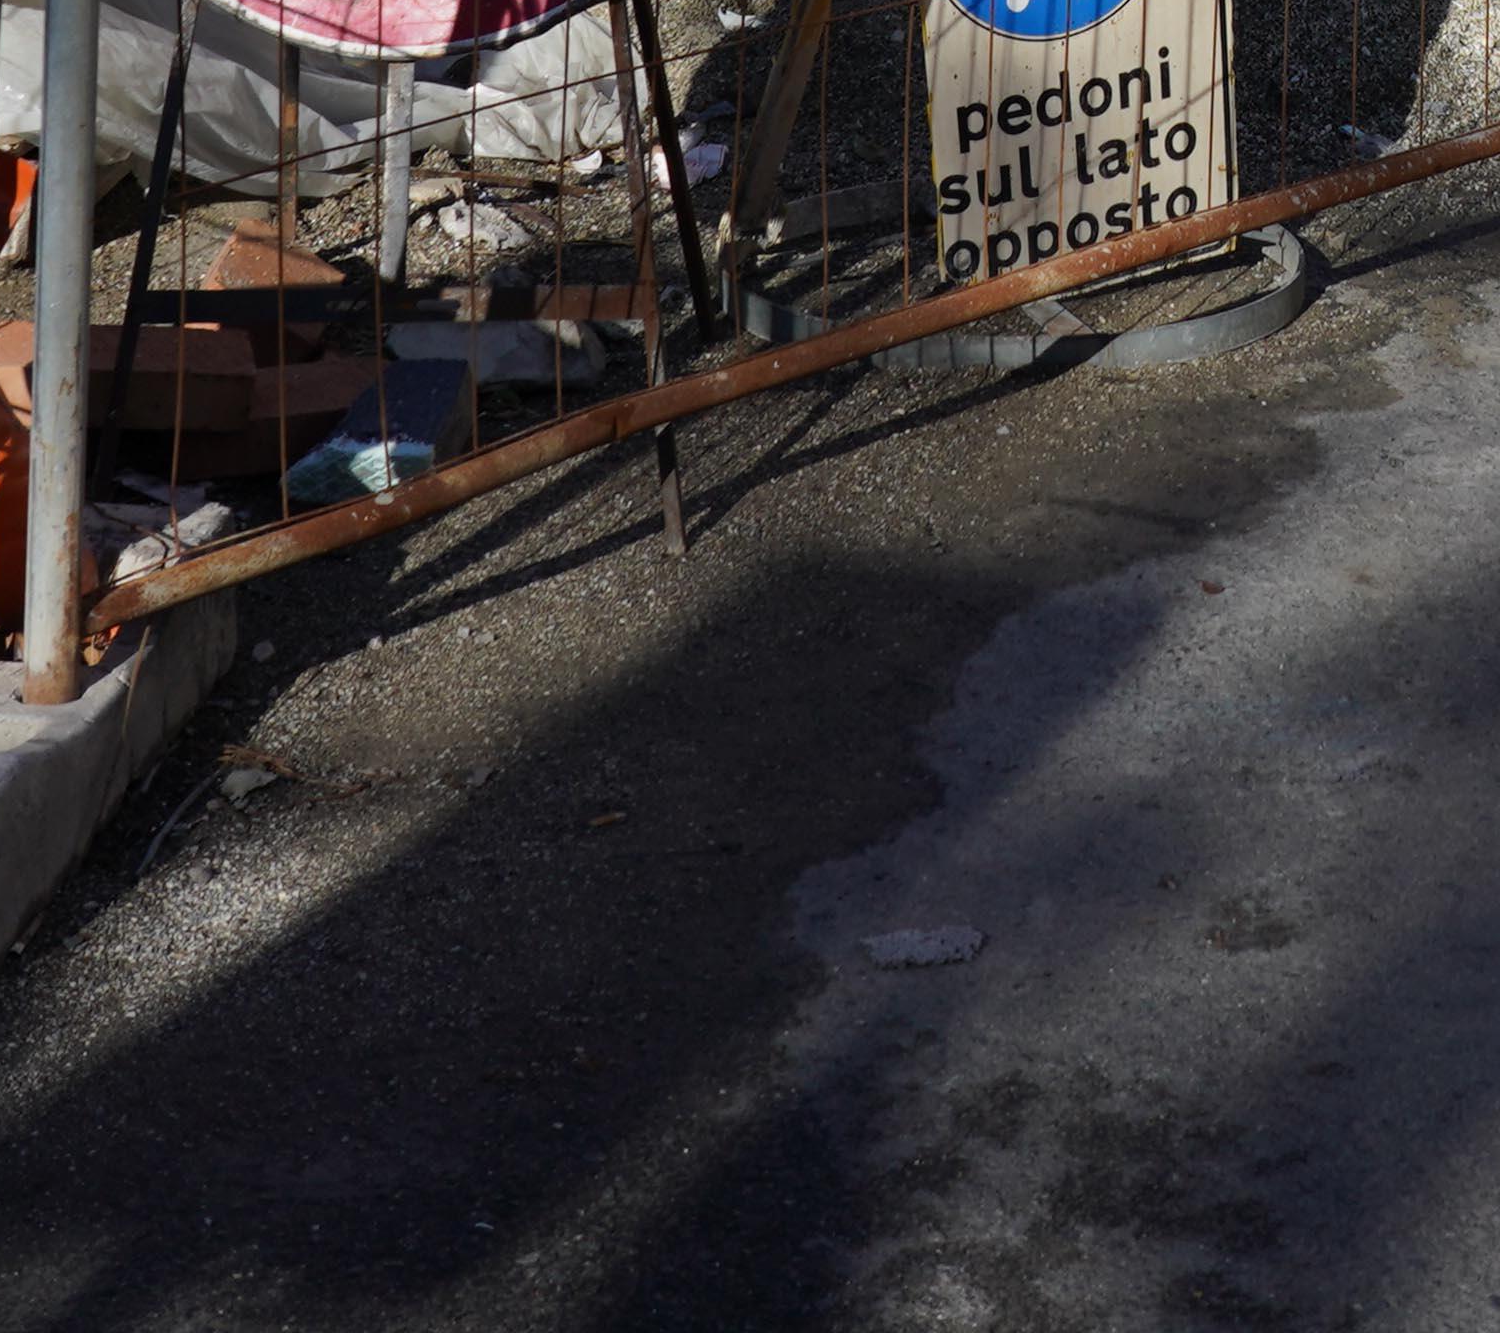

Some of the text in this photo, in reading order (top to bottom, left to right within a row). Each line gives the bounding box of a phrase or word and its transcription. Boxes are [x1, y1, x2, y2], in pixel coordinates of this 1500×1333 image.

[956, 45, 1172, 154] pedoni
[939, 117, 1197, 215] sul lato
[945, 182, 1198, 279] opposto
